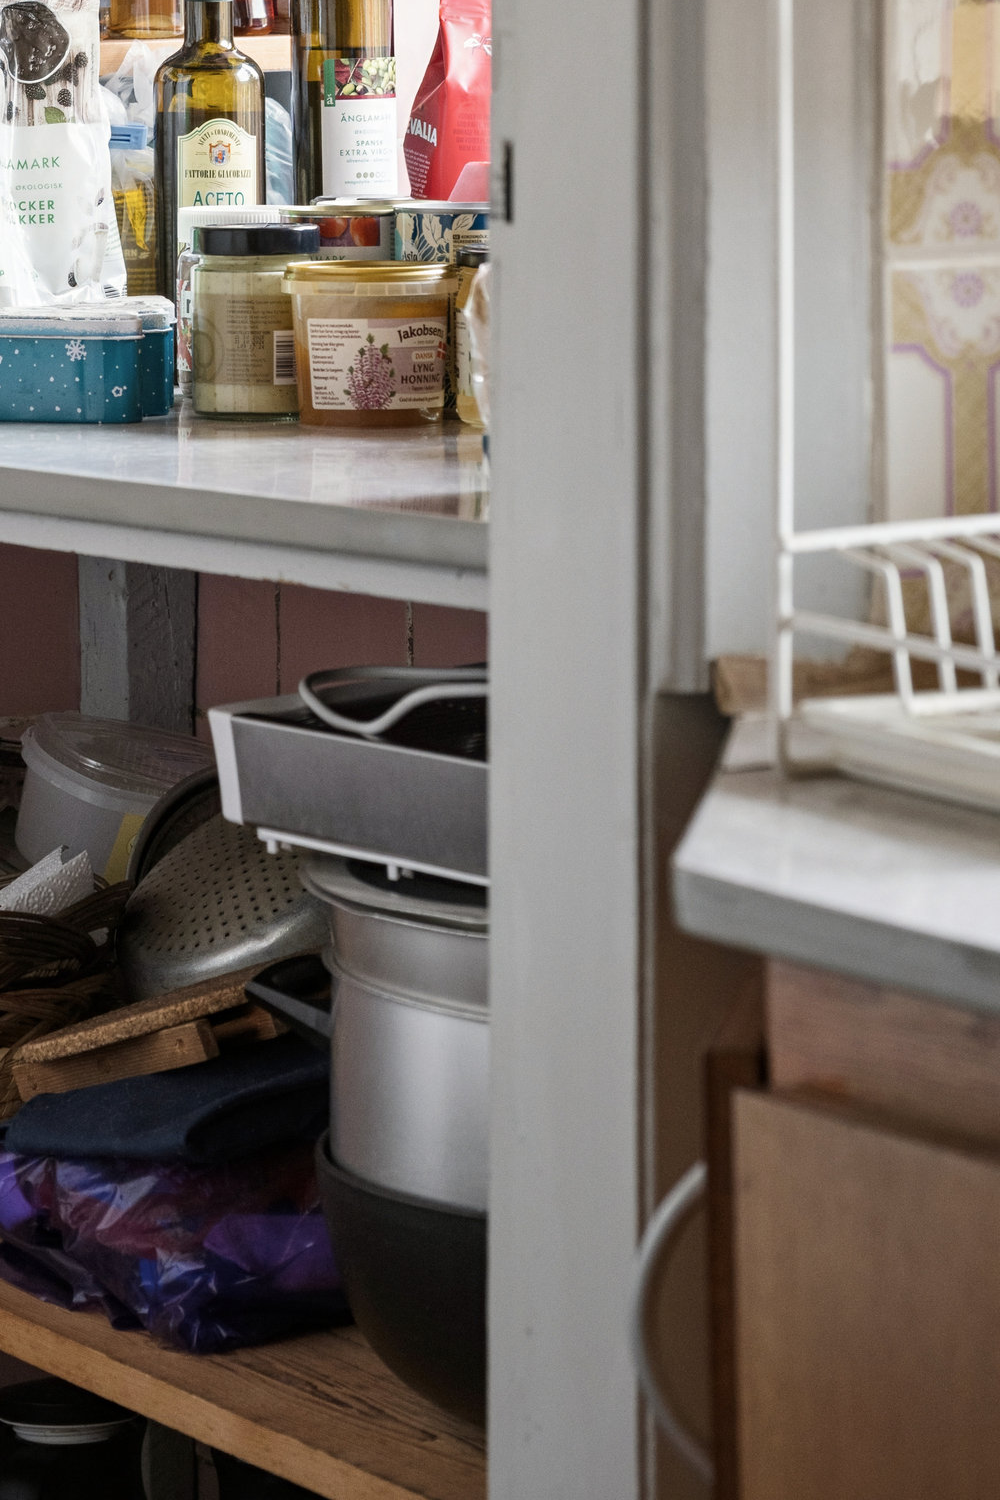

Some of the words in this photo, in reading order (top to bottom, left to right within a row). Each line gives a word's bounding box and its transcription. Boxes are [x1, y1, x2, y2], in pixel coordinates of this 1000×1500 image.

[408, 117, 437, 147] VALIA
[6, 156, 60, 170] AMARK
[184, 169, 216, 178] FATTORIE
[218, 169, 252, 178] GIACOBAZZI
[15, 183, 63, 191] ØKOLOGISK
[193, 190, 245, 206] ACETO
[10, 200, 55, 211] OCKER
[18, 214, 55, 225] KKER
[397, 324, 444, 343] Jakobsens
[413, 363, 434, 373] LYNG
[401, 373, 440, 384] HONNING
